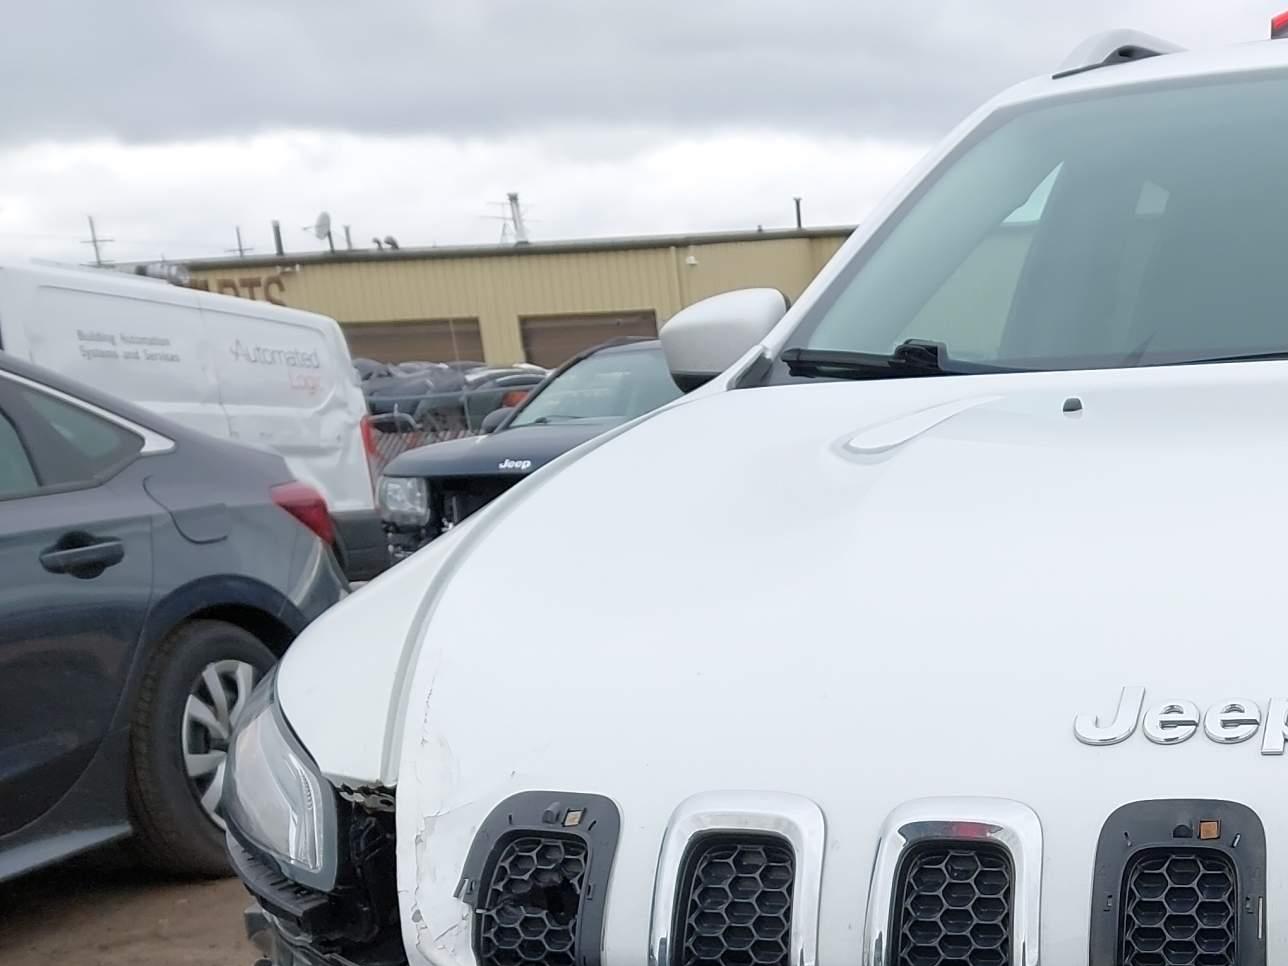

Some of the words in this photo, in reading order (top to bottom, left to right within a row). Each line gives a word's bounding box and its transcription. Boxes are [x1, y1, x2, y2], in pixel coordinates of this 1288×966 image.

[123, 349, 141, 361] and
[143, 348, 181, 362] Services
[231, 338, 321, 369] Automated
[498, 459, 532, 470] Jeep
